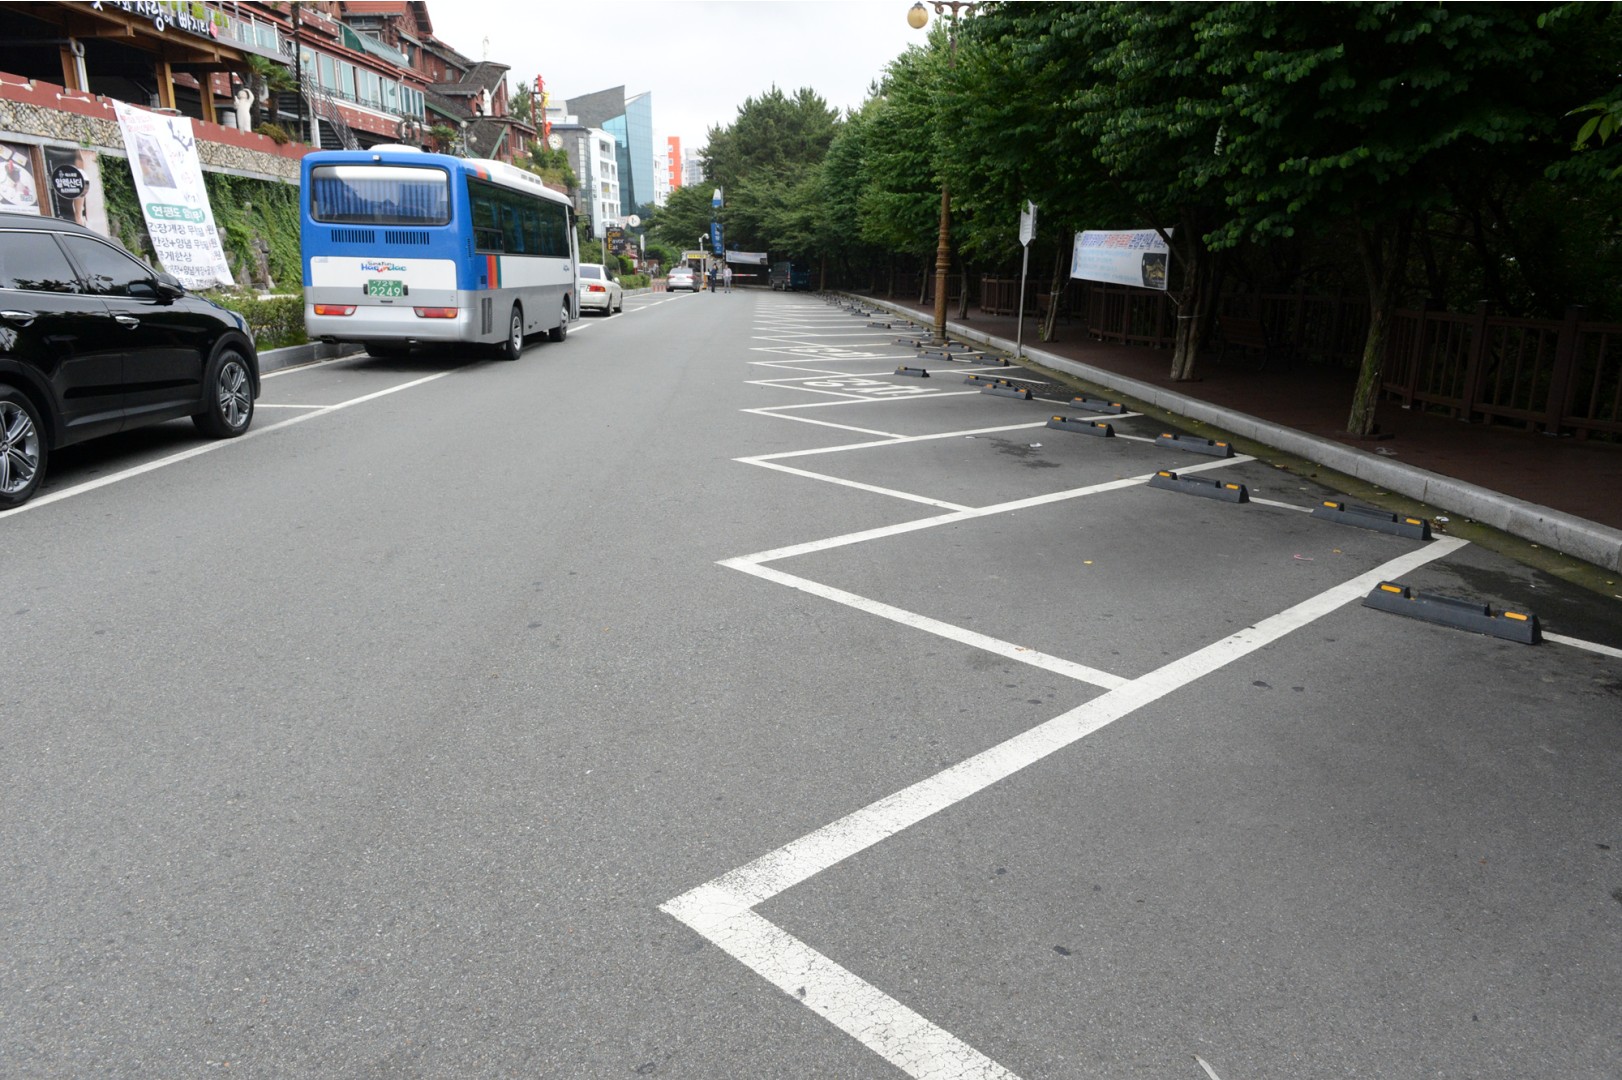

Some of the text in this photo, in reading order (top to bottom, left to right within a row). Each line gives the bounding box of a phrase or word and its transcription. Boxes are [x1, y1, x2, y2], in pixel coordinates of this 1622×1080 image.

[178, 11, 211, 36] 빠지다
[54, 177, 83, 188] 알렉산더
[151, 205, 182, 218] 연평도
[148, 222, 186, 235] 간장게장
[370, 286, 401, 297] 2249
